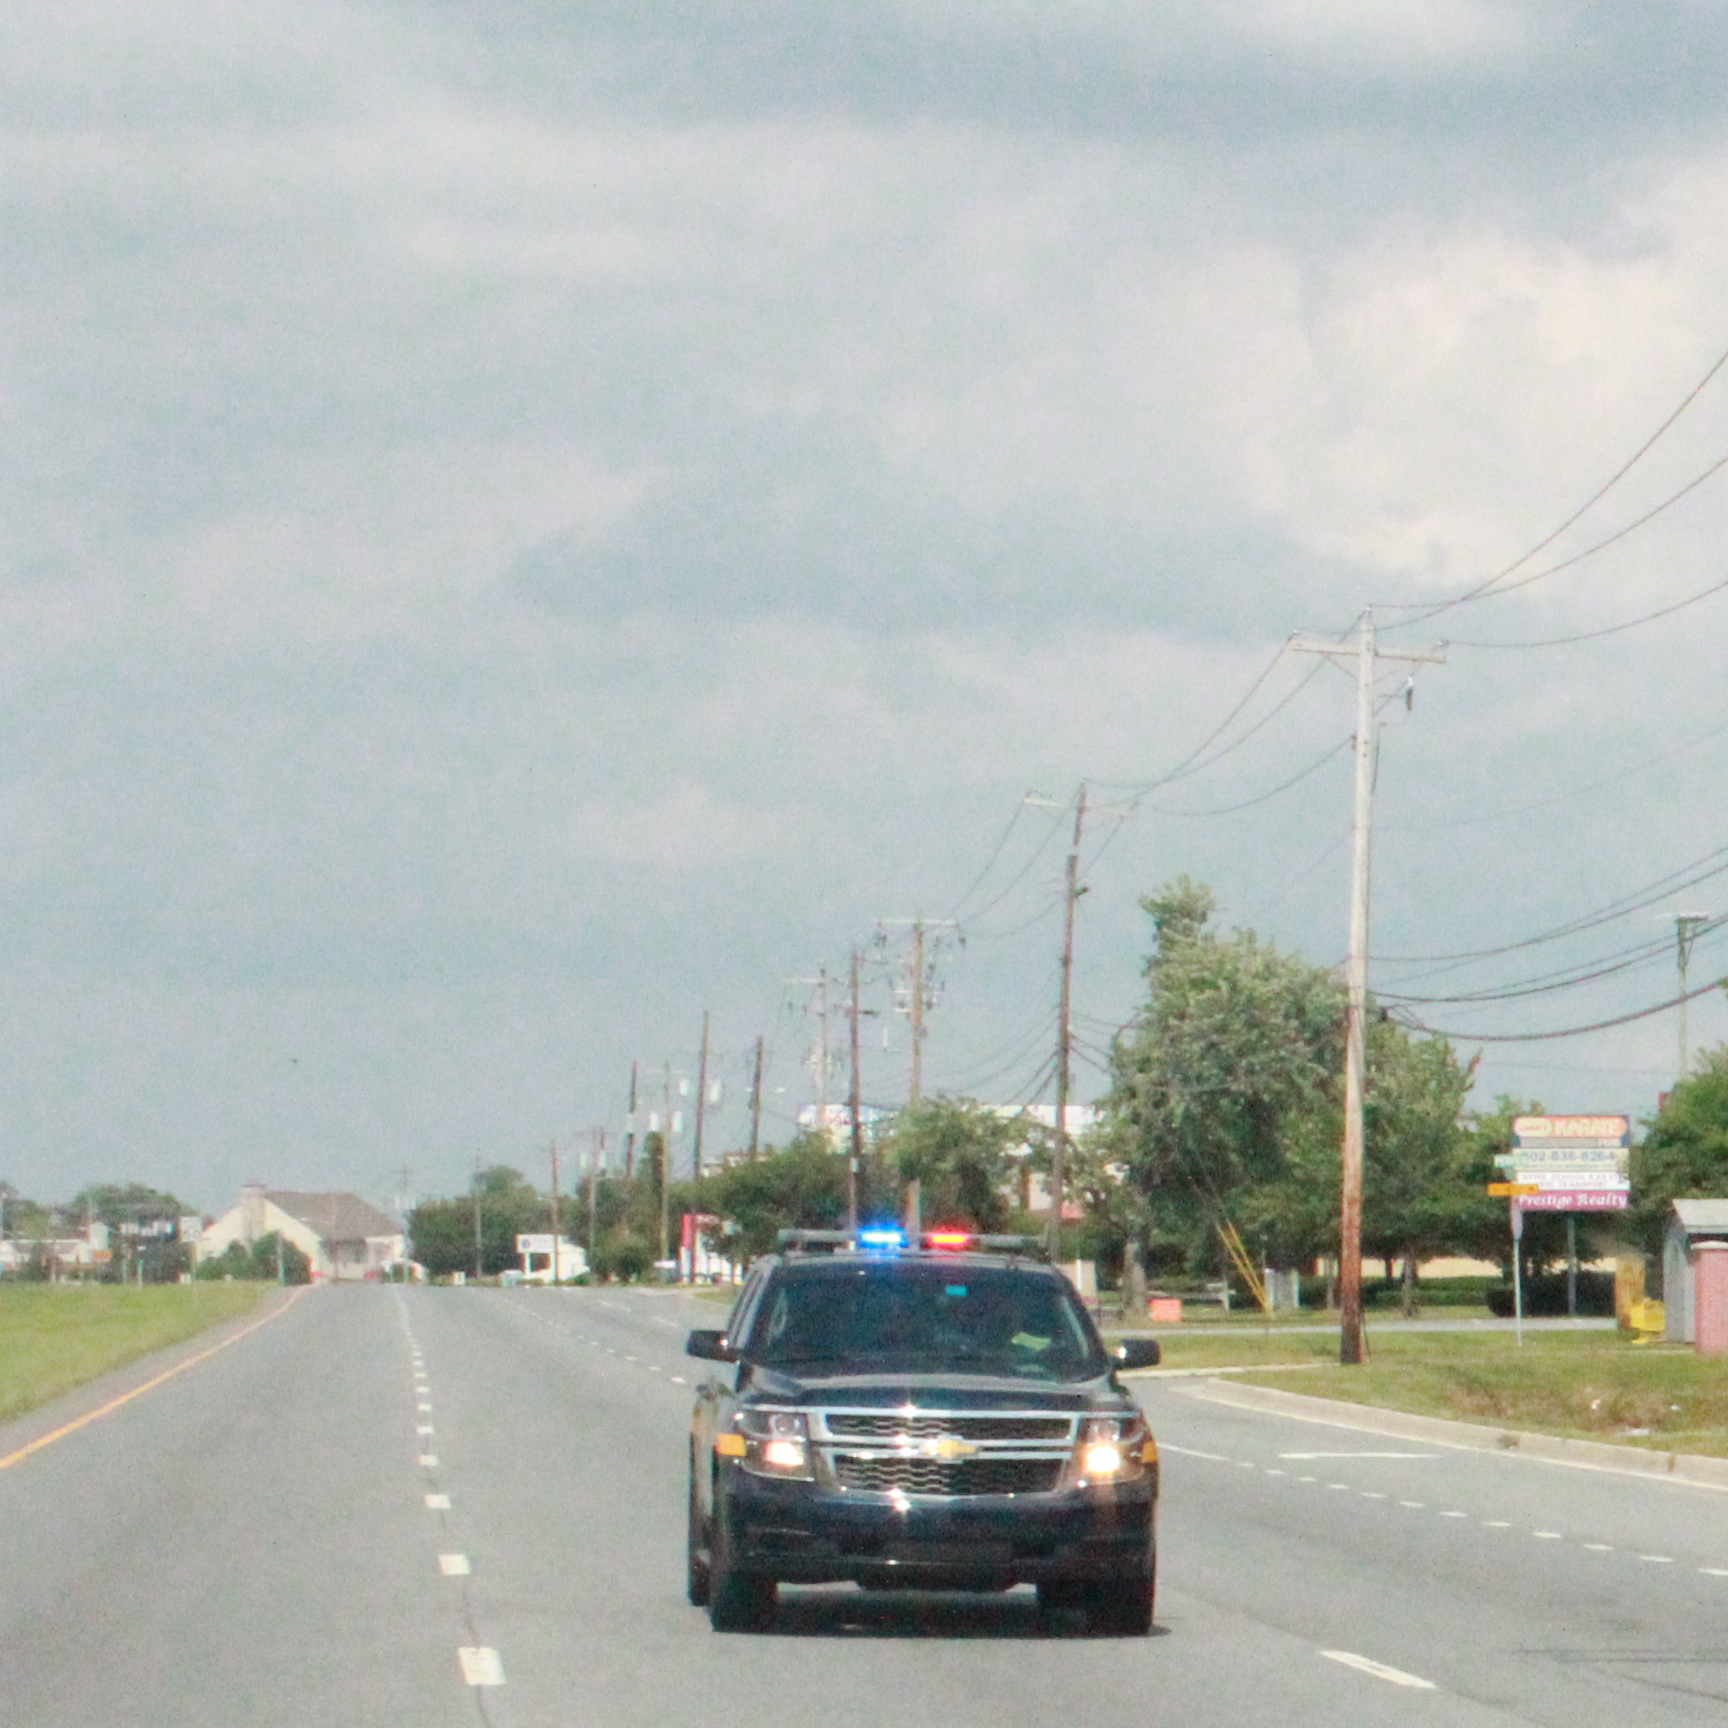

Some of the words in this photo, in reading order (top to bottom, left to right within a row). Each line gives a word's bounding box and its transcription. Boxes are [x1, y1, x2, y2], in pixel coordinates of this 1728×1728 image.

[1553, 1117, 1622, 1137] KARATE
[1519, 1193, 1573, 1210] Prestige
[1577, 1192, 1628, 1209] Realty
